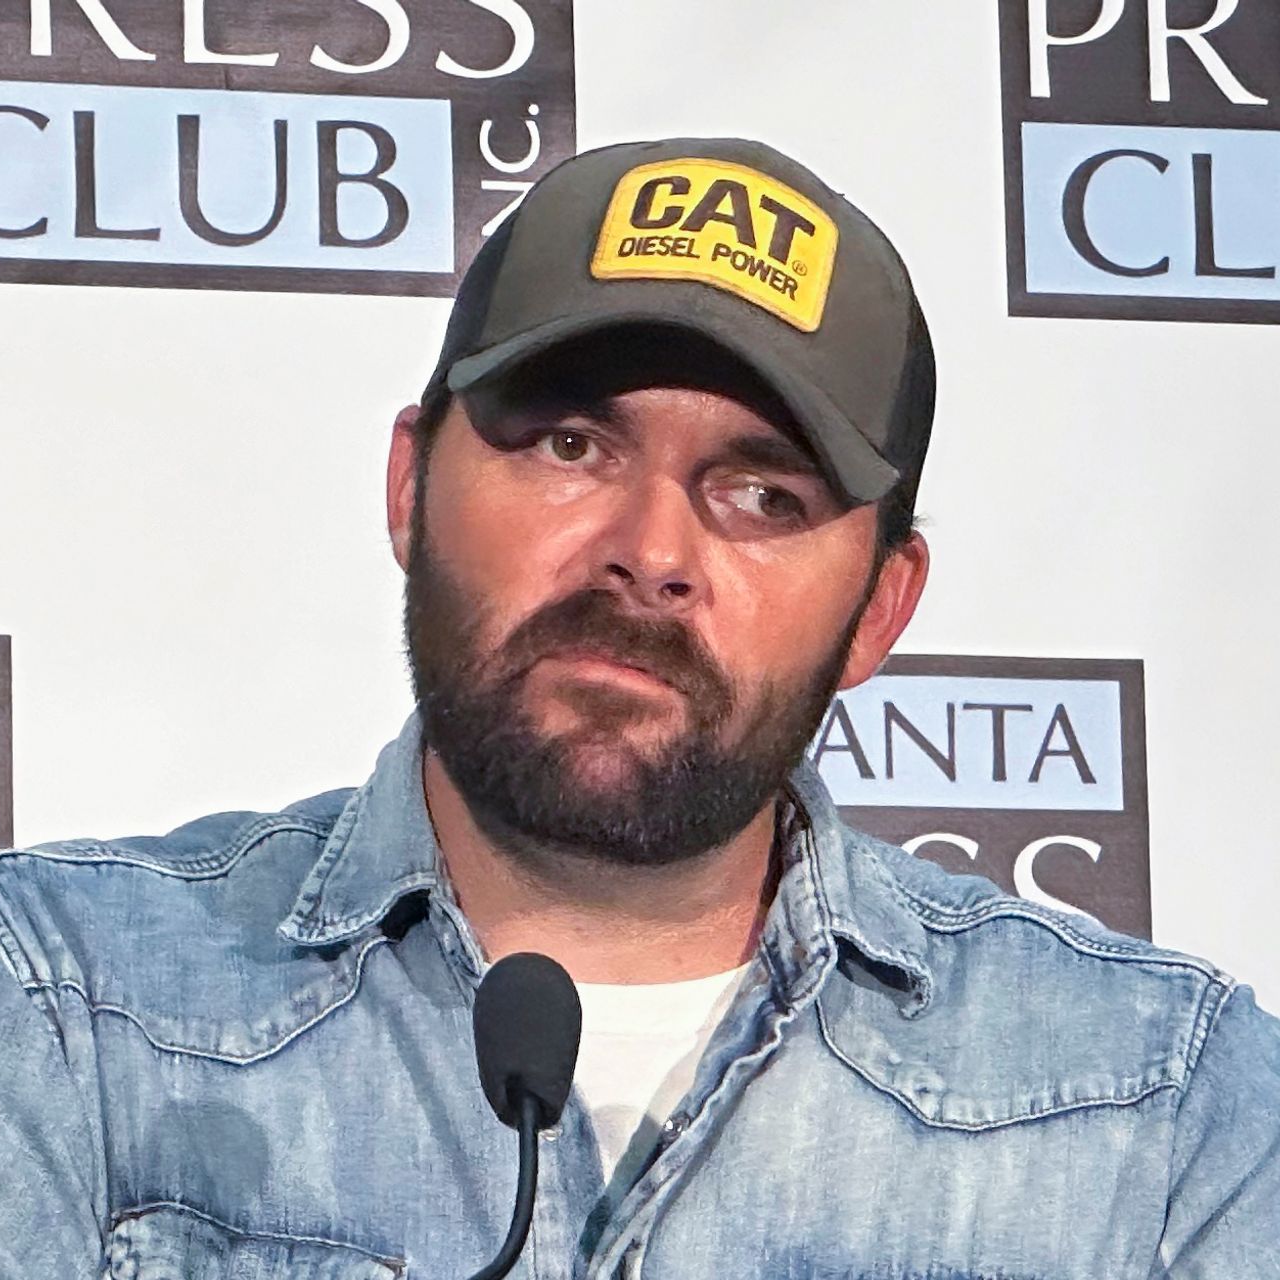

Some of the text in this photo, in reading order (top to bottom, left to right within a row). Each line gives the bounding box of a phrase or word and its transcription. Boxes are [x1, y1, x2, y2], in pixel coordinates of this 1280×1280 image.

[479, 103, 541, 237] NC.
[629, 175, 816, 265] CAT
[617, 235, 798, 301] DIESEL POWER
[815, 698, 1098, 785] ANTA
